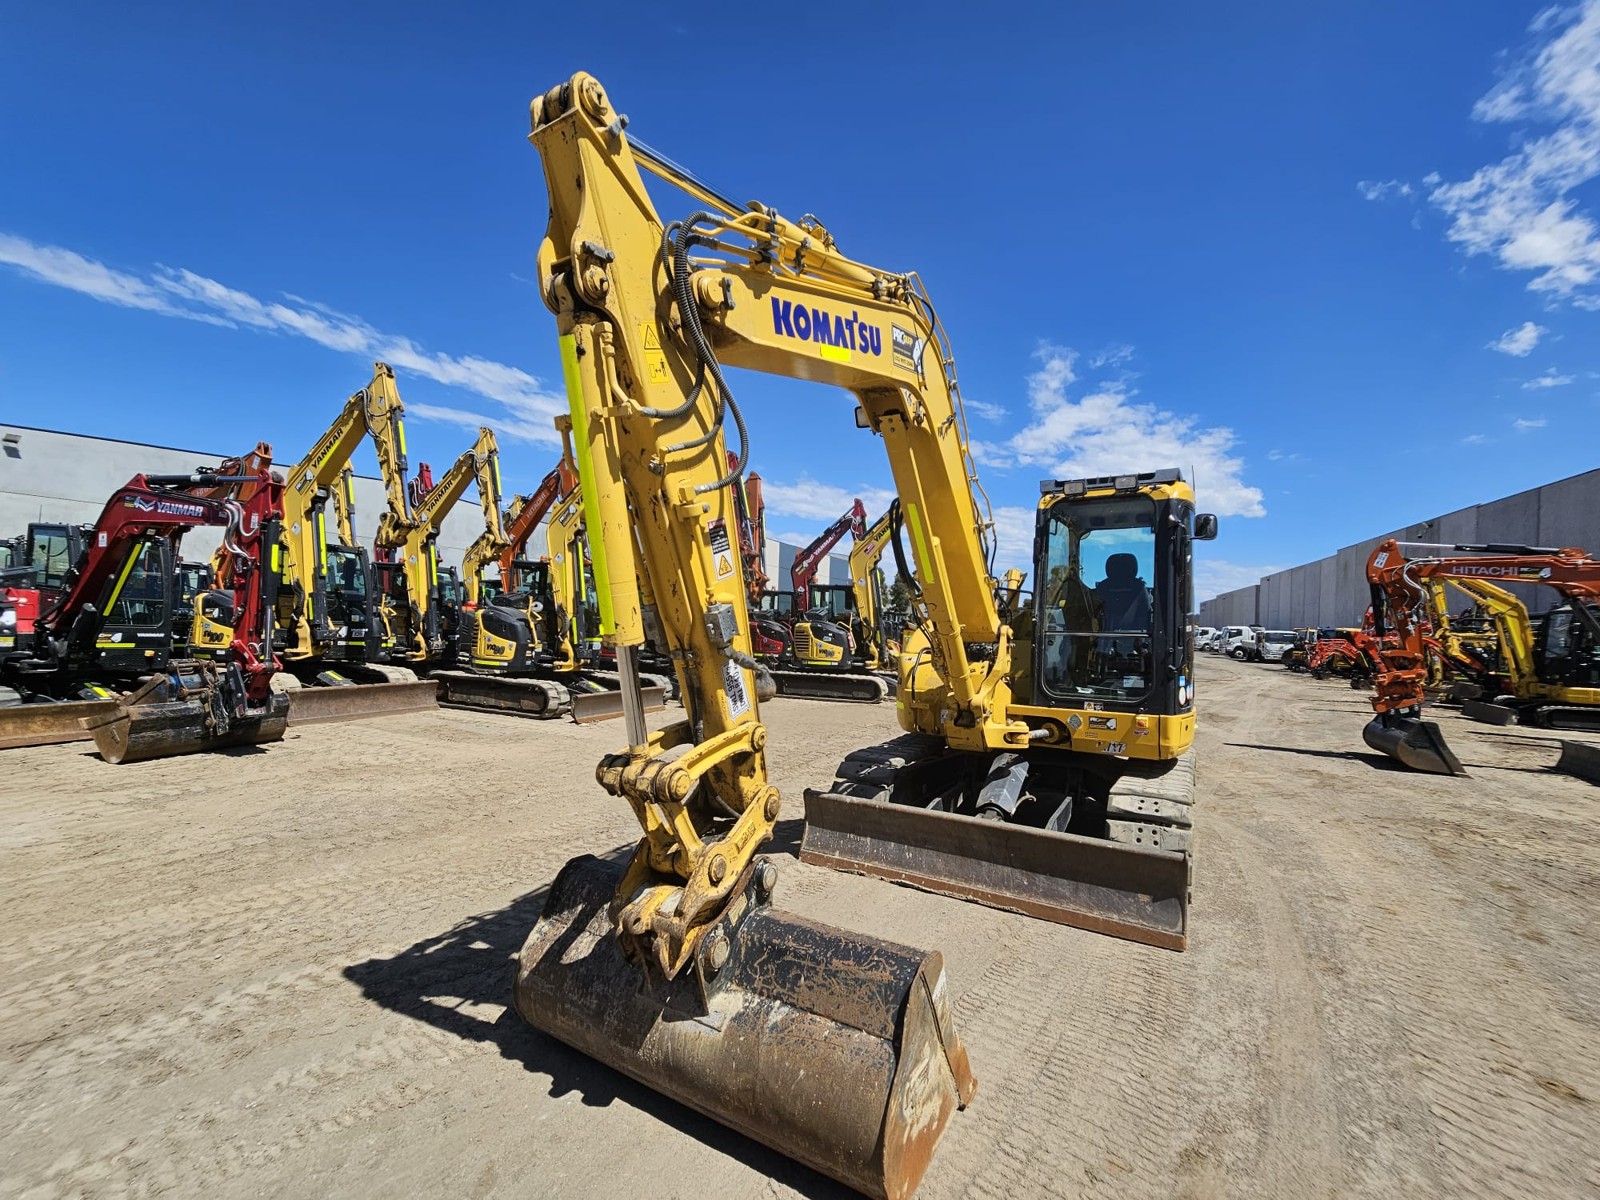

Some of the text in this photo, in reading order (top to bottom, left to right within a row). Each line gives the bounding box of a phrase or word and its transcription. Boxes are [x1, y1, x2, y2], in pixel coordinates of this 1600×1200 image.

[771, 296, 882, 356] KOMATSU
[312, 428, 344, 469] YANMAR
[156, 501, 204, 517] YANMAR
[426, 480, 453, 512] YANMAR
[1452, 566, 1519, 576] HITACHI
